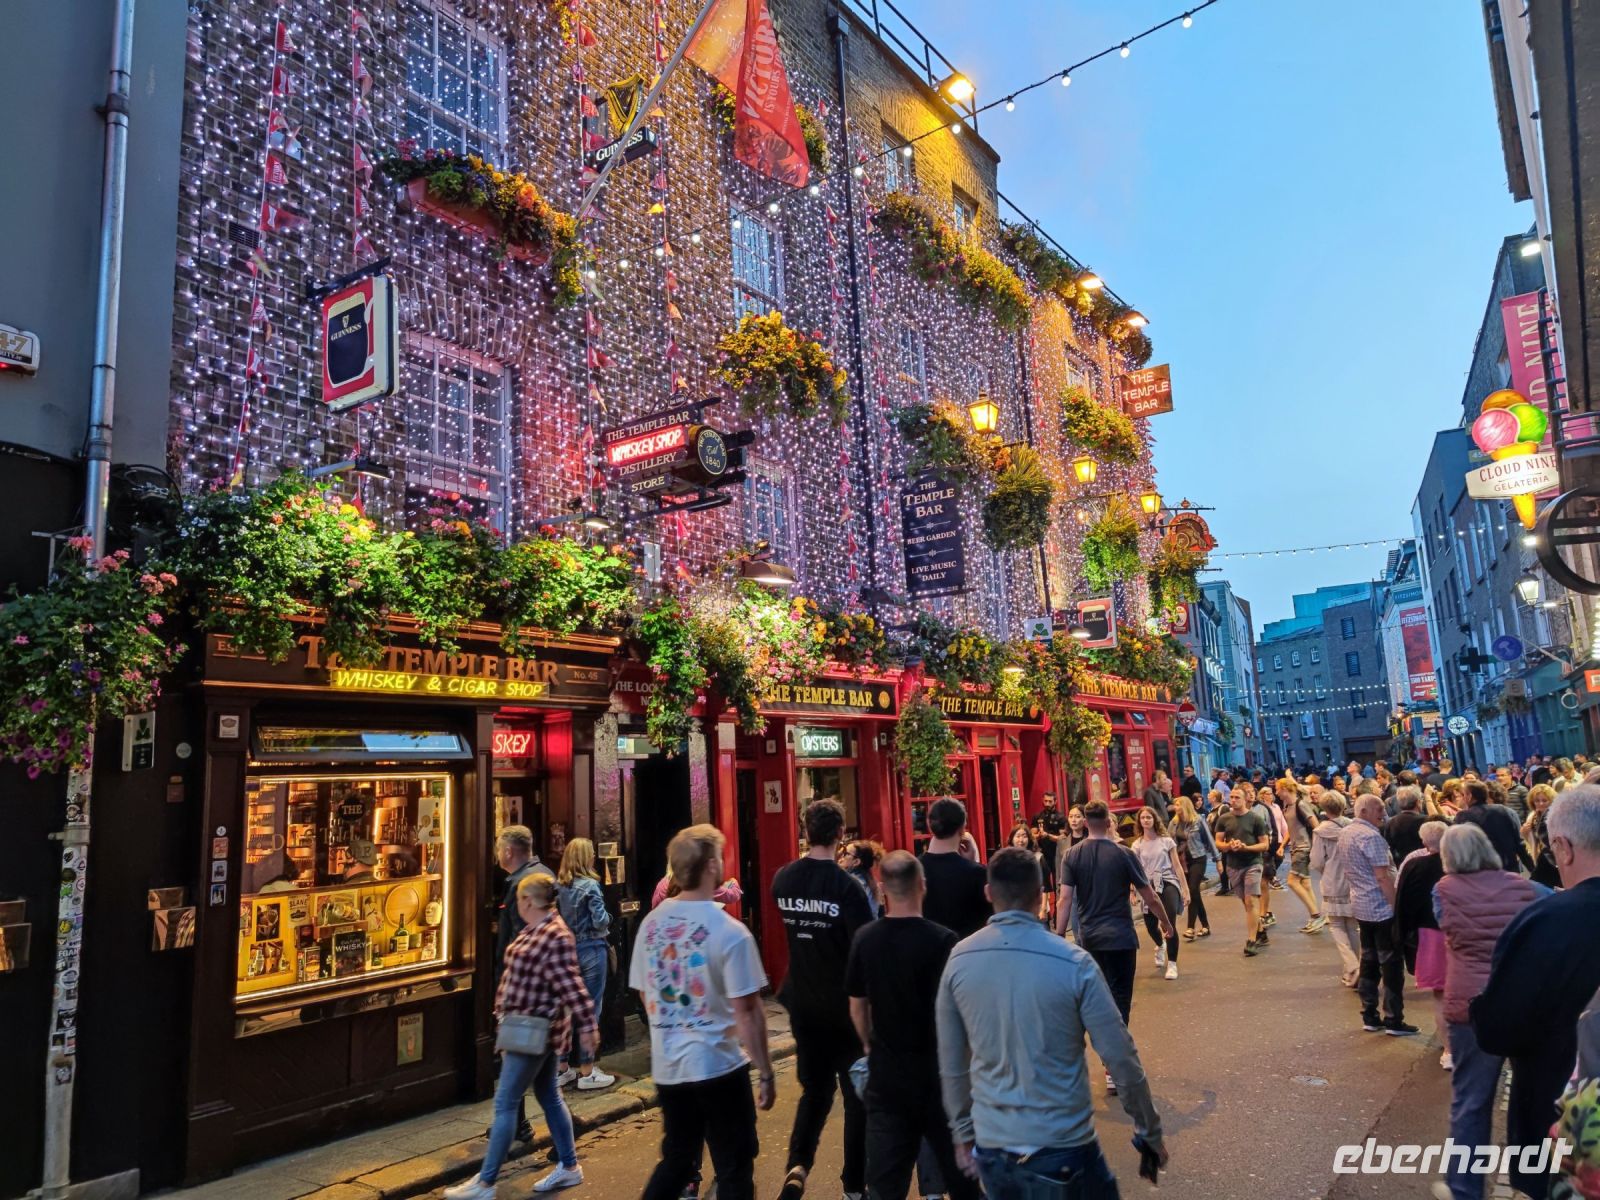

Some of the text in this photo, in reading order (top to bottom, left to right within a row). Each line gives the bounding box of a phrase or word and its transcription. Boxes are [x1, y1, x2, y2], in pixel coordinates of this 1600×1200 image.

[330, 322, 363, 342] GUINNESS
[1130, 371, 1155, 385] THE
[1123, 381, 1169, 401] TEMPLE
[1134, 398, 1158, 413] BAR
[606, 410, 690, 443] THE TEMPLE BAR
[611, 429, 682, 463] WHISKEY SHOP
[620, 452, 677, 476] DISTILLERY
[705, 455, 720, 468] 1840
[1479, 454, 1557, 483] CLOUD NINE
[631, 476, 665, 493] STORE
[919, 481, 937, 491] THE
[1494, 475, 1551, 493] GELATERIA
[903, 488, 955, 507] TEMPLE
[915, 504, 944, 518] BAR
[907, 530, 957, 545] BEER GARDEN
[911, 560, 957, 574] LIVE MUSIC
[922, 571, 947, 582] DAILY
[382, 645, 499, 679] TEMPLE
[504, 657, 560, 686] BAR
[337, 671, 543, 697] WHISKEY & CIGAR SHOP
[615, 681, 633, 692] THE
[1081, 681, 1158, 701] THE TEMPLE BAR
[792, 685, 847, 706] TEMPLE
[849, 691, 874, 708] BAR
[940, 697, 1024, 718] THE TEMPLE BAR
[492, 733, 531, 755] SKEY
[802, 736, 839, 751] OYSTERS
[341, 804, 363, 815] THE
[335, 942, 367, 952] WHISKY
